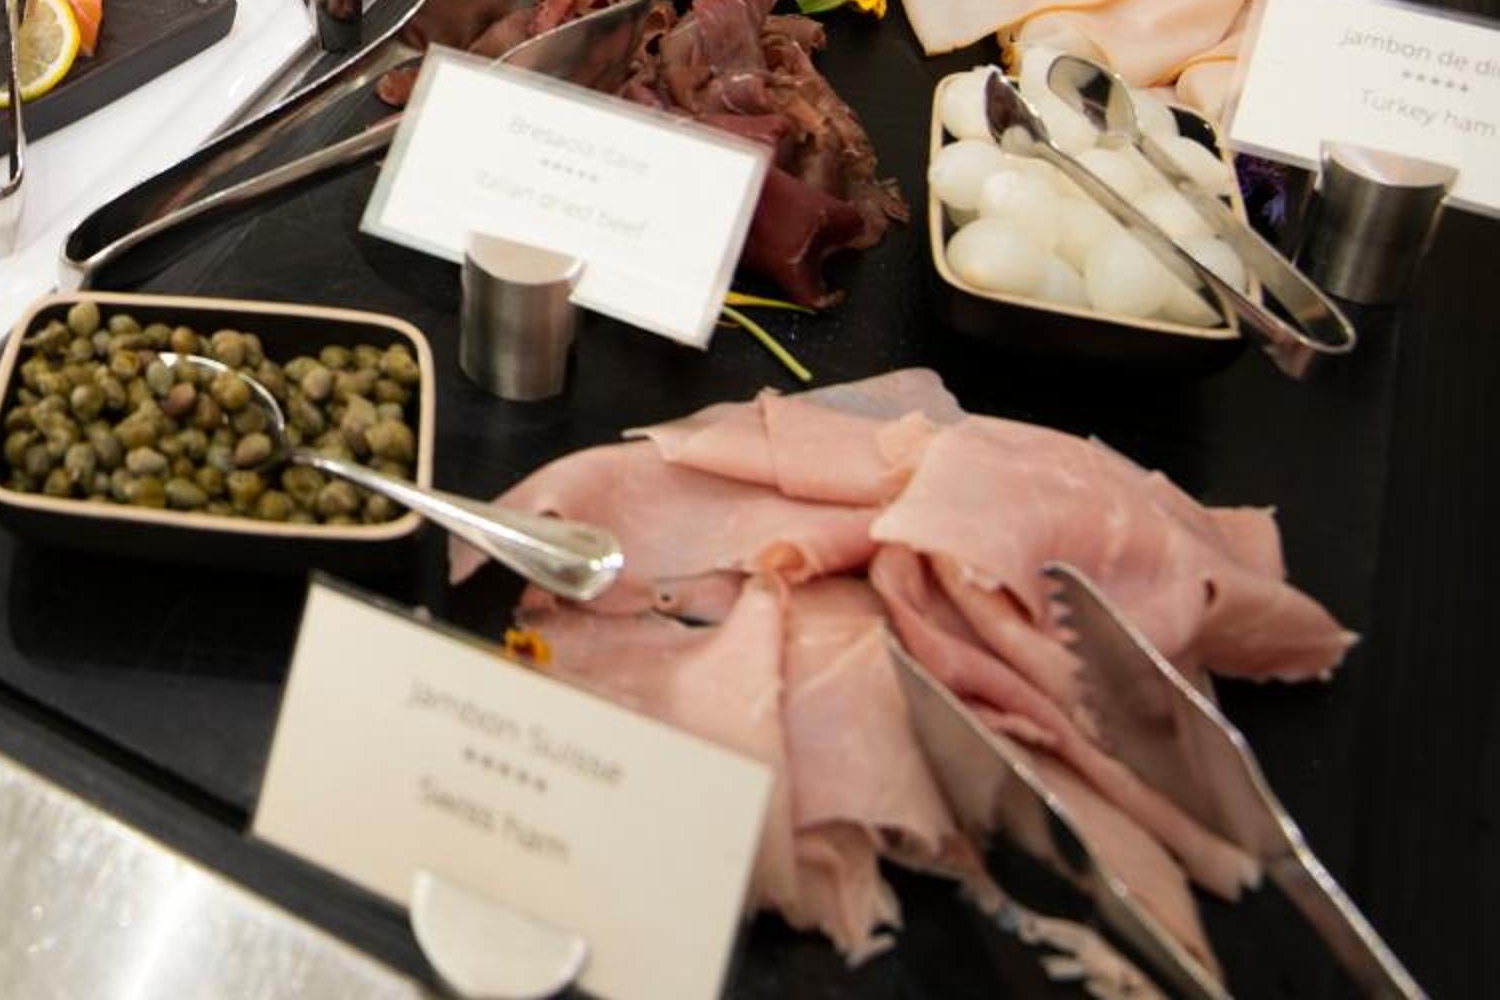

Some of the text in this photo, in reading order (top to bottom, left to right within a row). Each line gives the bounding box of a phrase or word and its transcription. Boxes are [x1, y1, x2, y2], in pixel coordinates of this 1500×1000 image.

[1437, 48, 1469, 72] de
[1360, 89, 1496, 137] Turkey ham
[530, 725, 623, 782] Suisse
[420, 777, 568, 859] Swiss ham
